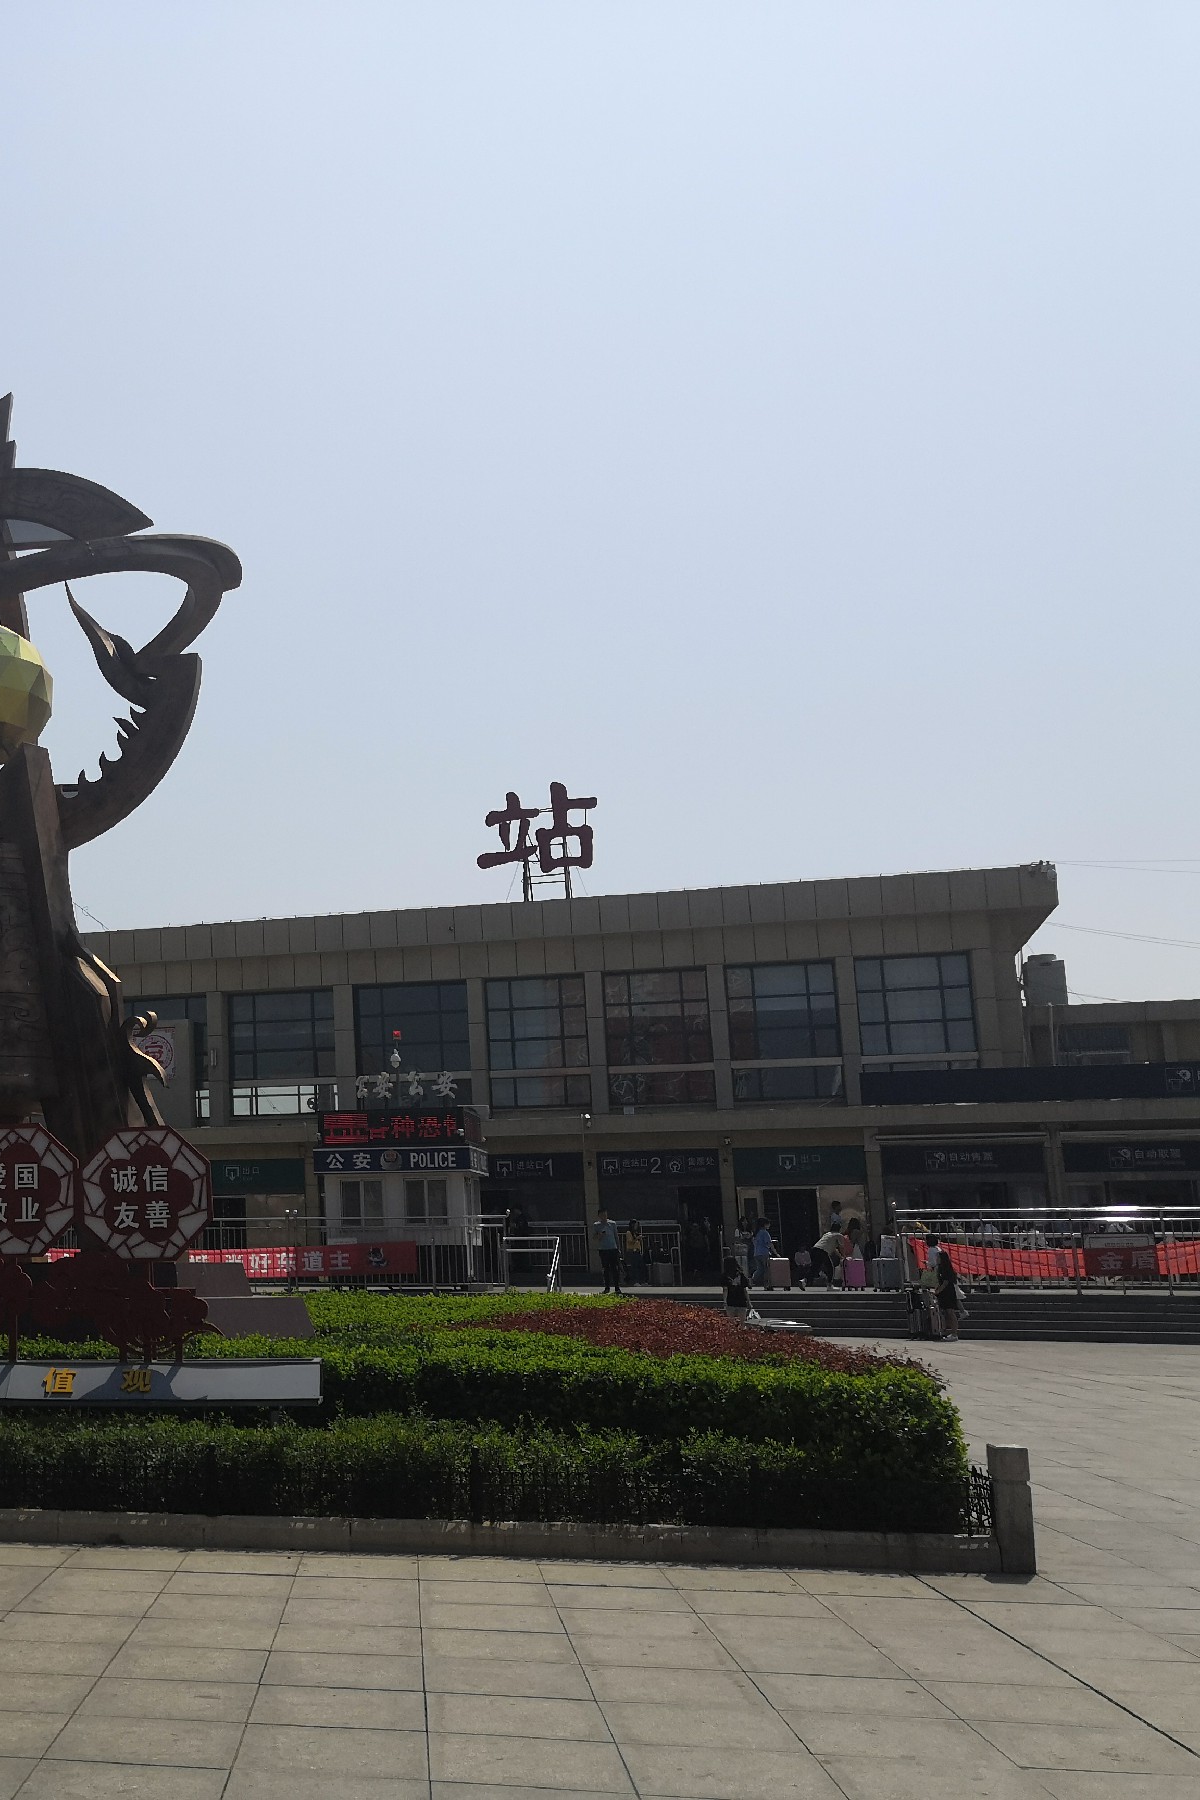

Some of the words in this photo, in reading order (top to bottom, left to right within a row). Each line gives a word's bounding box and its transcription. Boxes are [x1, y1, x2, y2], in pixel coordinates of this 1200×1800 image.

[477, 781, 597, 873] 站
[242, 1166, 260, 1175] 出口
[326, 1152, 372, 1170] 公安
[410, 1151, 457, 1168] POLICE
[650, 1157, 662, 1174] 2
[111, 1164, 169, 1193] 诚信
[113, 1200, 172, 1229] 友善
[1097, 1249, 1155, 1270] 金盾
